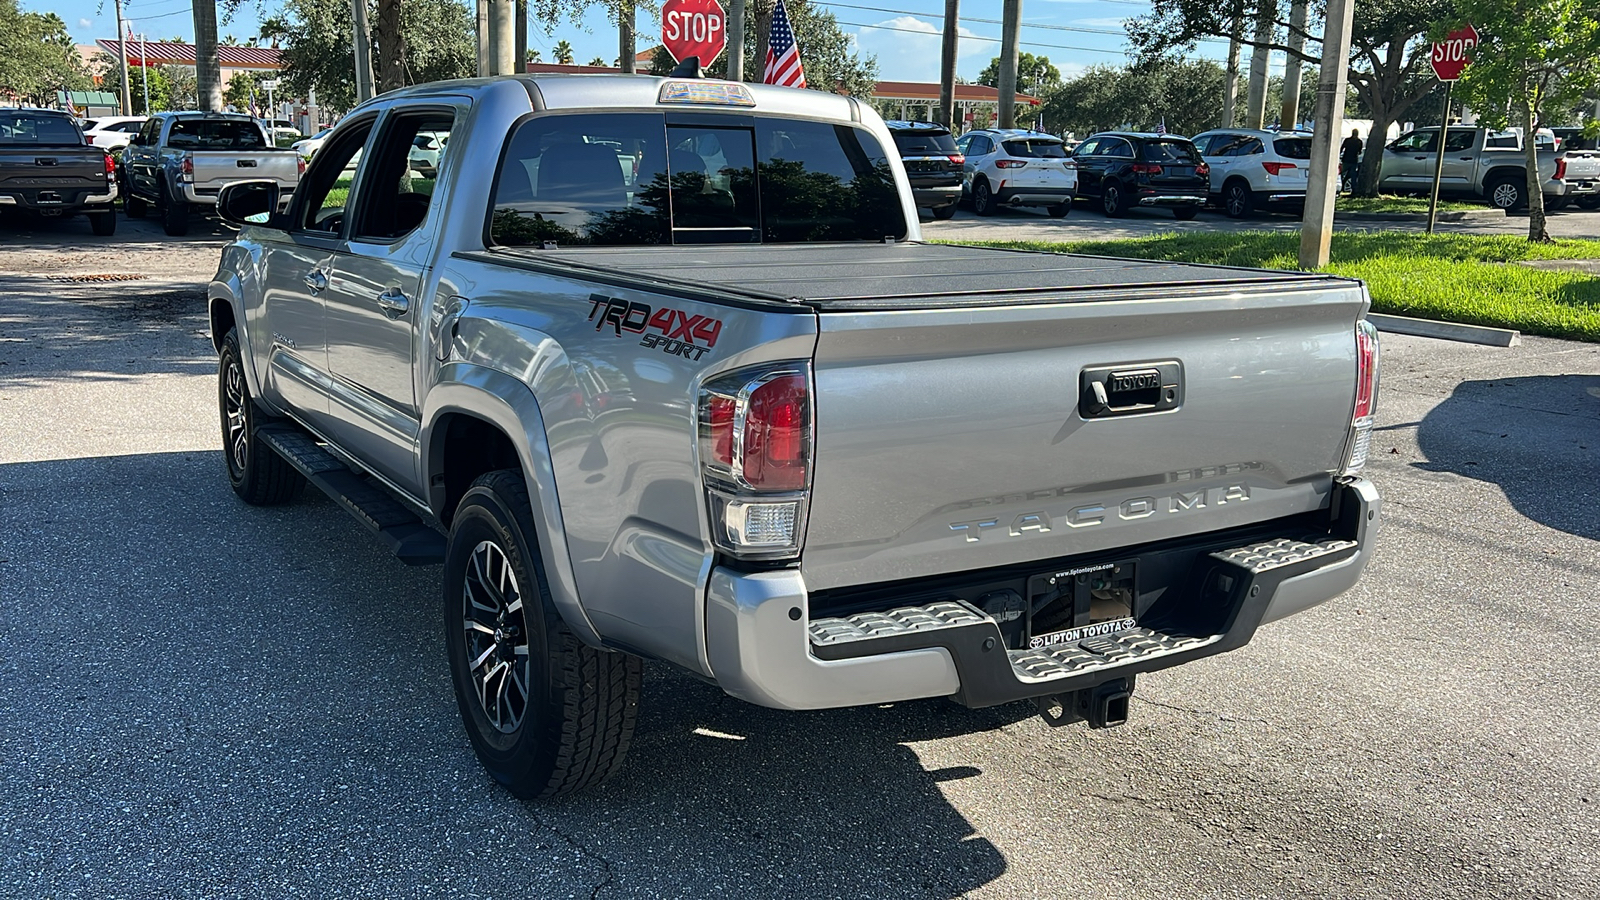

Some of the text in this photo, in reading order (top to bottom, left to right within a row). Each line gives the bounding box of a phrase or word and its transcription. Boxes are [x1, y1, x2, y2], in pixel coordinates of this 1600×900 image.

[667, 11, 721, 43] STOP
[588, 293, 651, 338] TRD
[639, 332, 711, 362] SPORT
[1113, 373, 1160, 392] TOYOTA
[949, 482, 1251, 542] TACOMA
[1055, 563, 1114, 578] www.liptontoyota.com
[1043, 620, 1122, 646] LIPTON TOYOTA
